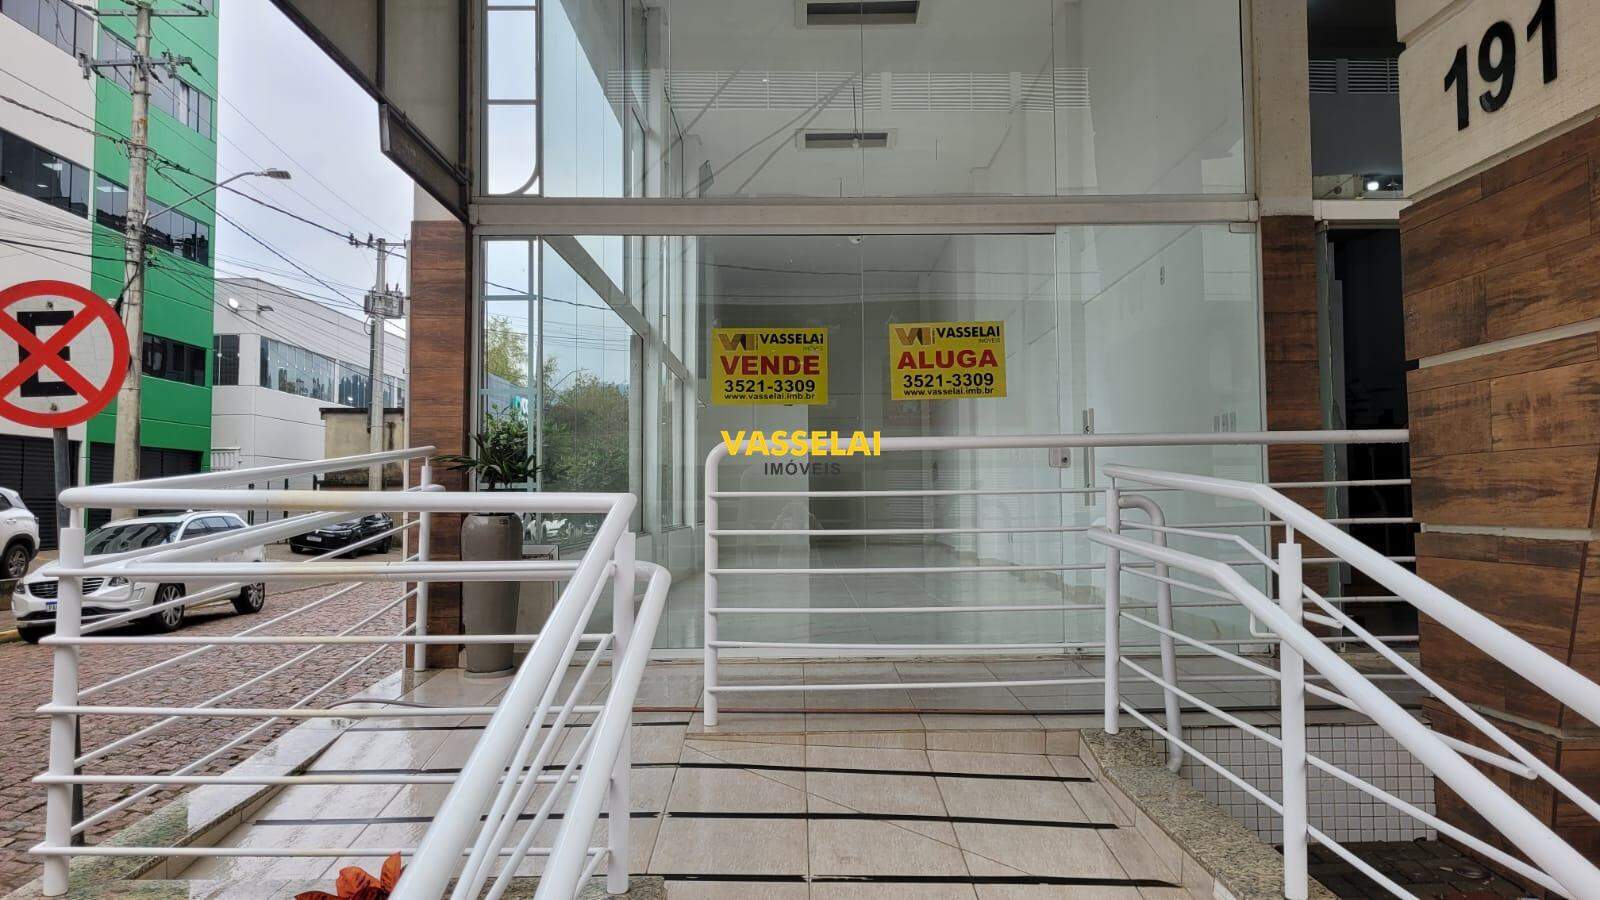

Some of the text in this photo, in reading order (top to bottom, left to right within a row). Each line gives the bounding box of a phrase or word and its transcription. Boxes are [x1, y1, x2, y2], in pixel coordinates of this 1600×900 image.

[1444, 0, 1558, 131] 191
[936, 326, 1000, 338] VASSELAI
[760, 333, 824, 344] VASSELAI
[720, 355, 820, 375] VENDE
[897, 349, 998, 369] ALUGA
[724, 380, 815, 392] 3521-3309
[903, 373, 994, 388] 3521-3309
[724, 392, 815, 400] www.vasselai.imb.br
[903, 387, 994, 396] www.vasselai.imb.br
